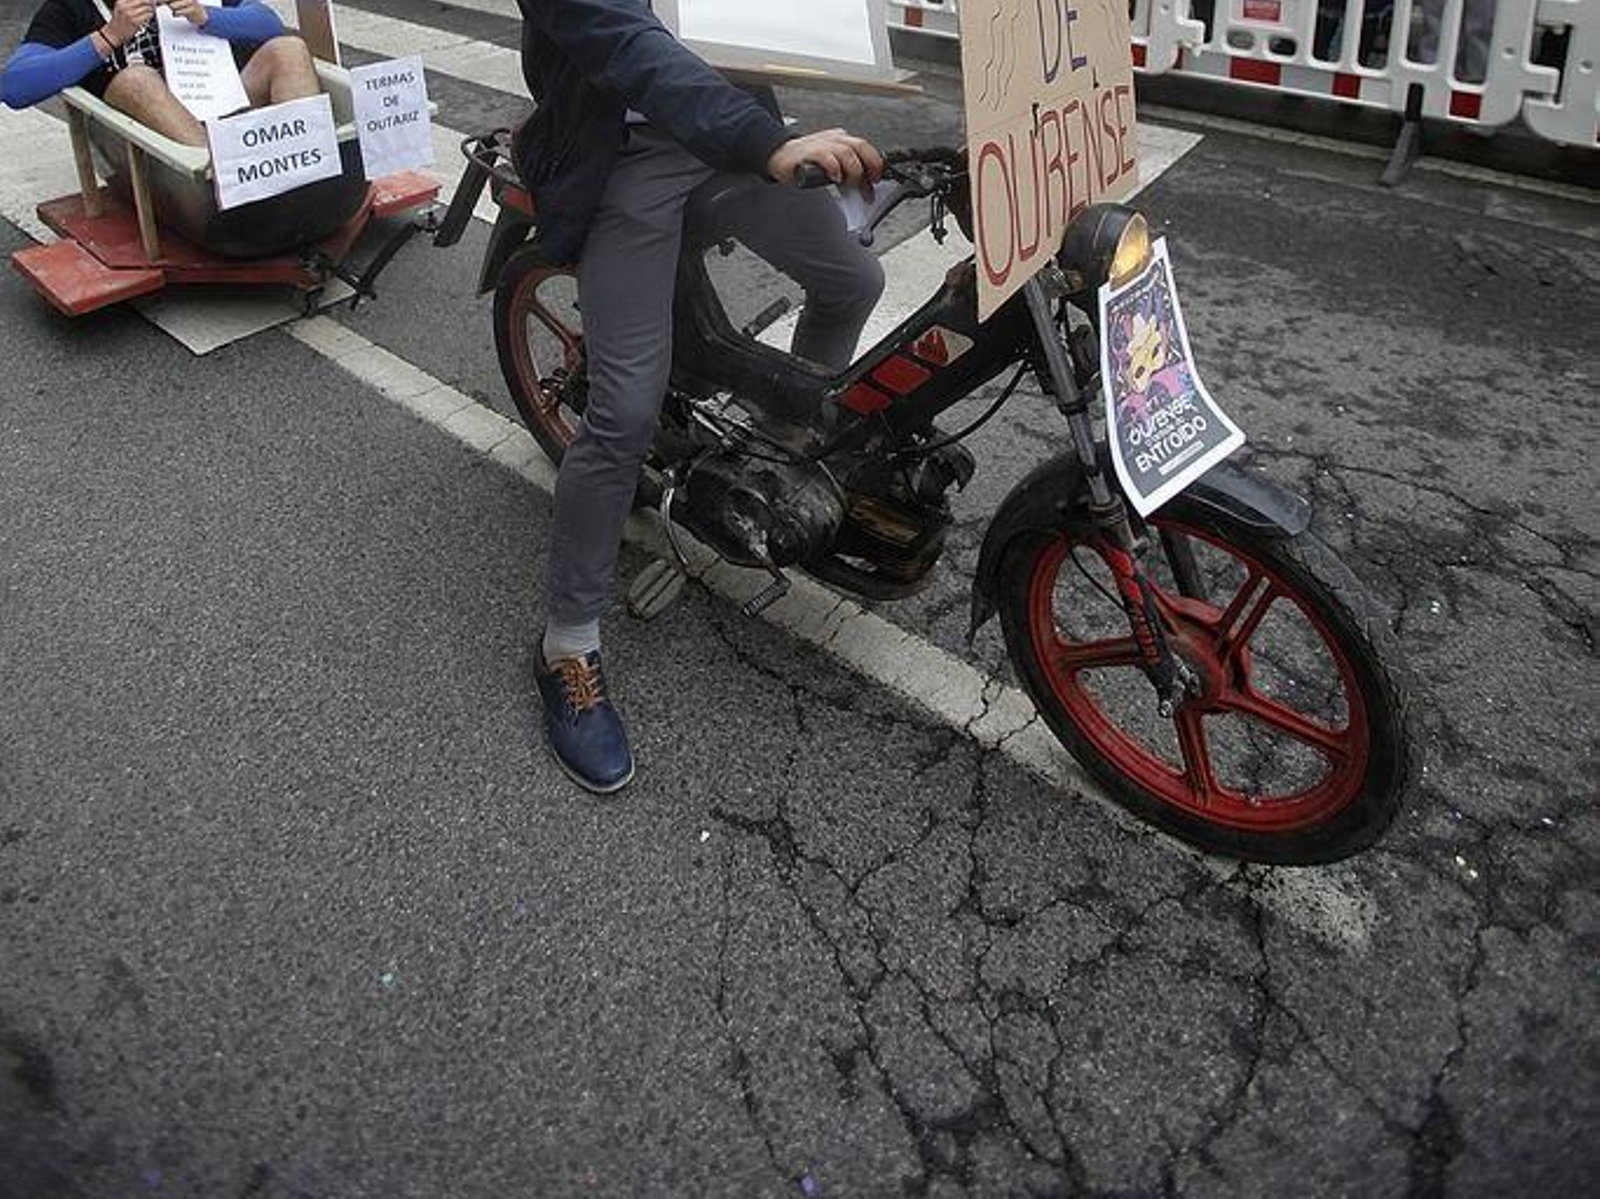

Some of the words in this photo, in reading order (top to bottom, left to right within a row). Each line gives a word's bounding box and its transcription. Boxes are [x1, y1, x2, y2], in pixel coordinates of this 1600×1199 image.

[365, 70, 415, 91] TERMAS
[383, 95, 398, 107] DE
[242, 119, 307, 148] OMAR
[366, 110, 419, 133] OUTARIZ
[237, 148, 322, 184] MONTES
[978, 84, 1136, 287] OURENSE
